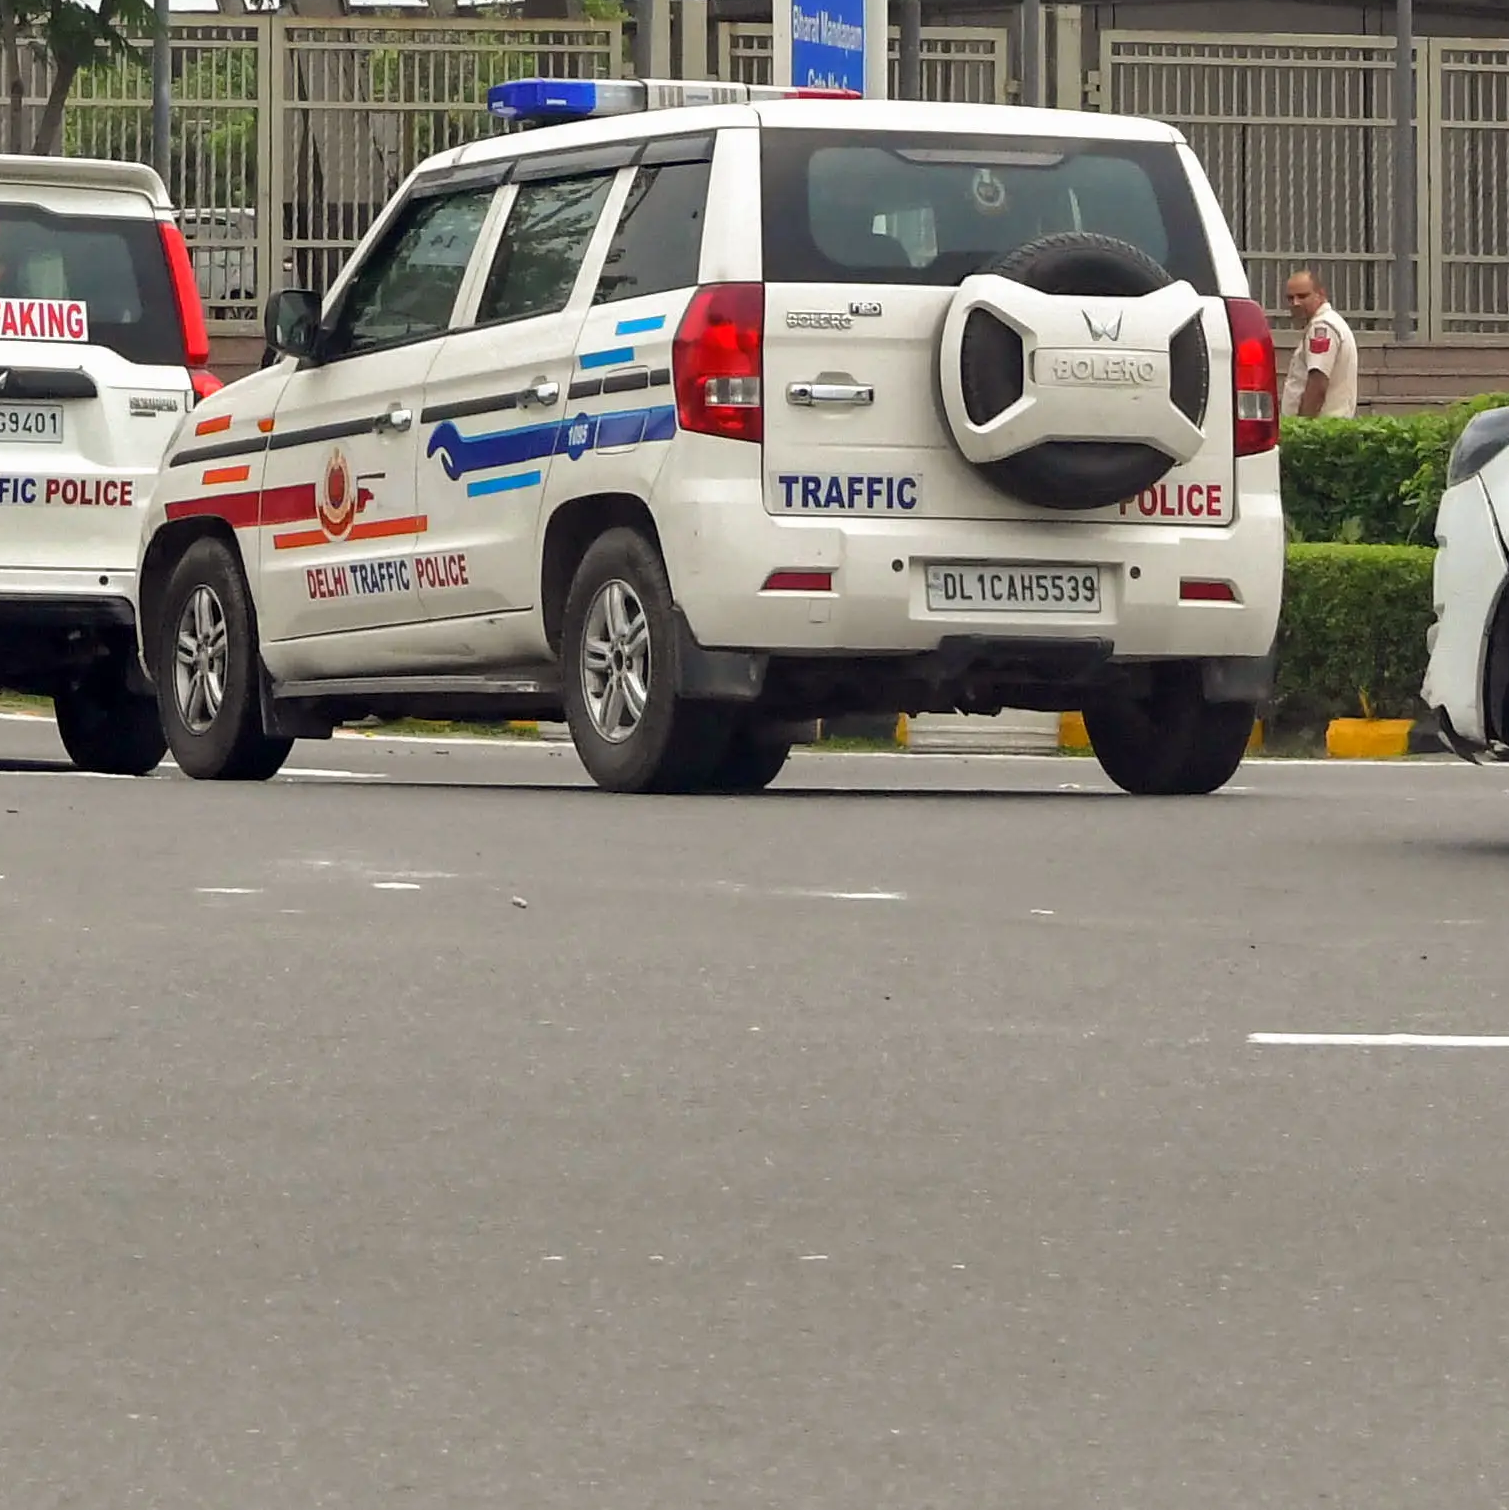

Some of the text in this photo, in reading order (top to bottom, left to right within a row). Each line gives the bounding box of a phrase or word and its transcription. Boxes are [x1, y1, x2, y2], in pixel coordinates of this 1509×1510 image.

[786, 311, 856, 330] BOLERO
[1052, 356, 1155, 385] BOLERO
[44, 478, 134, 507] POLICE
[778, 474, 918, 511] TRAFFIC
[305, 553, 469, 600] DELHI TRAFFIC POLICE
[943, 572, 1096, 603] DL1CAH5539
